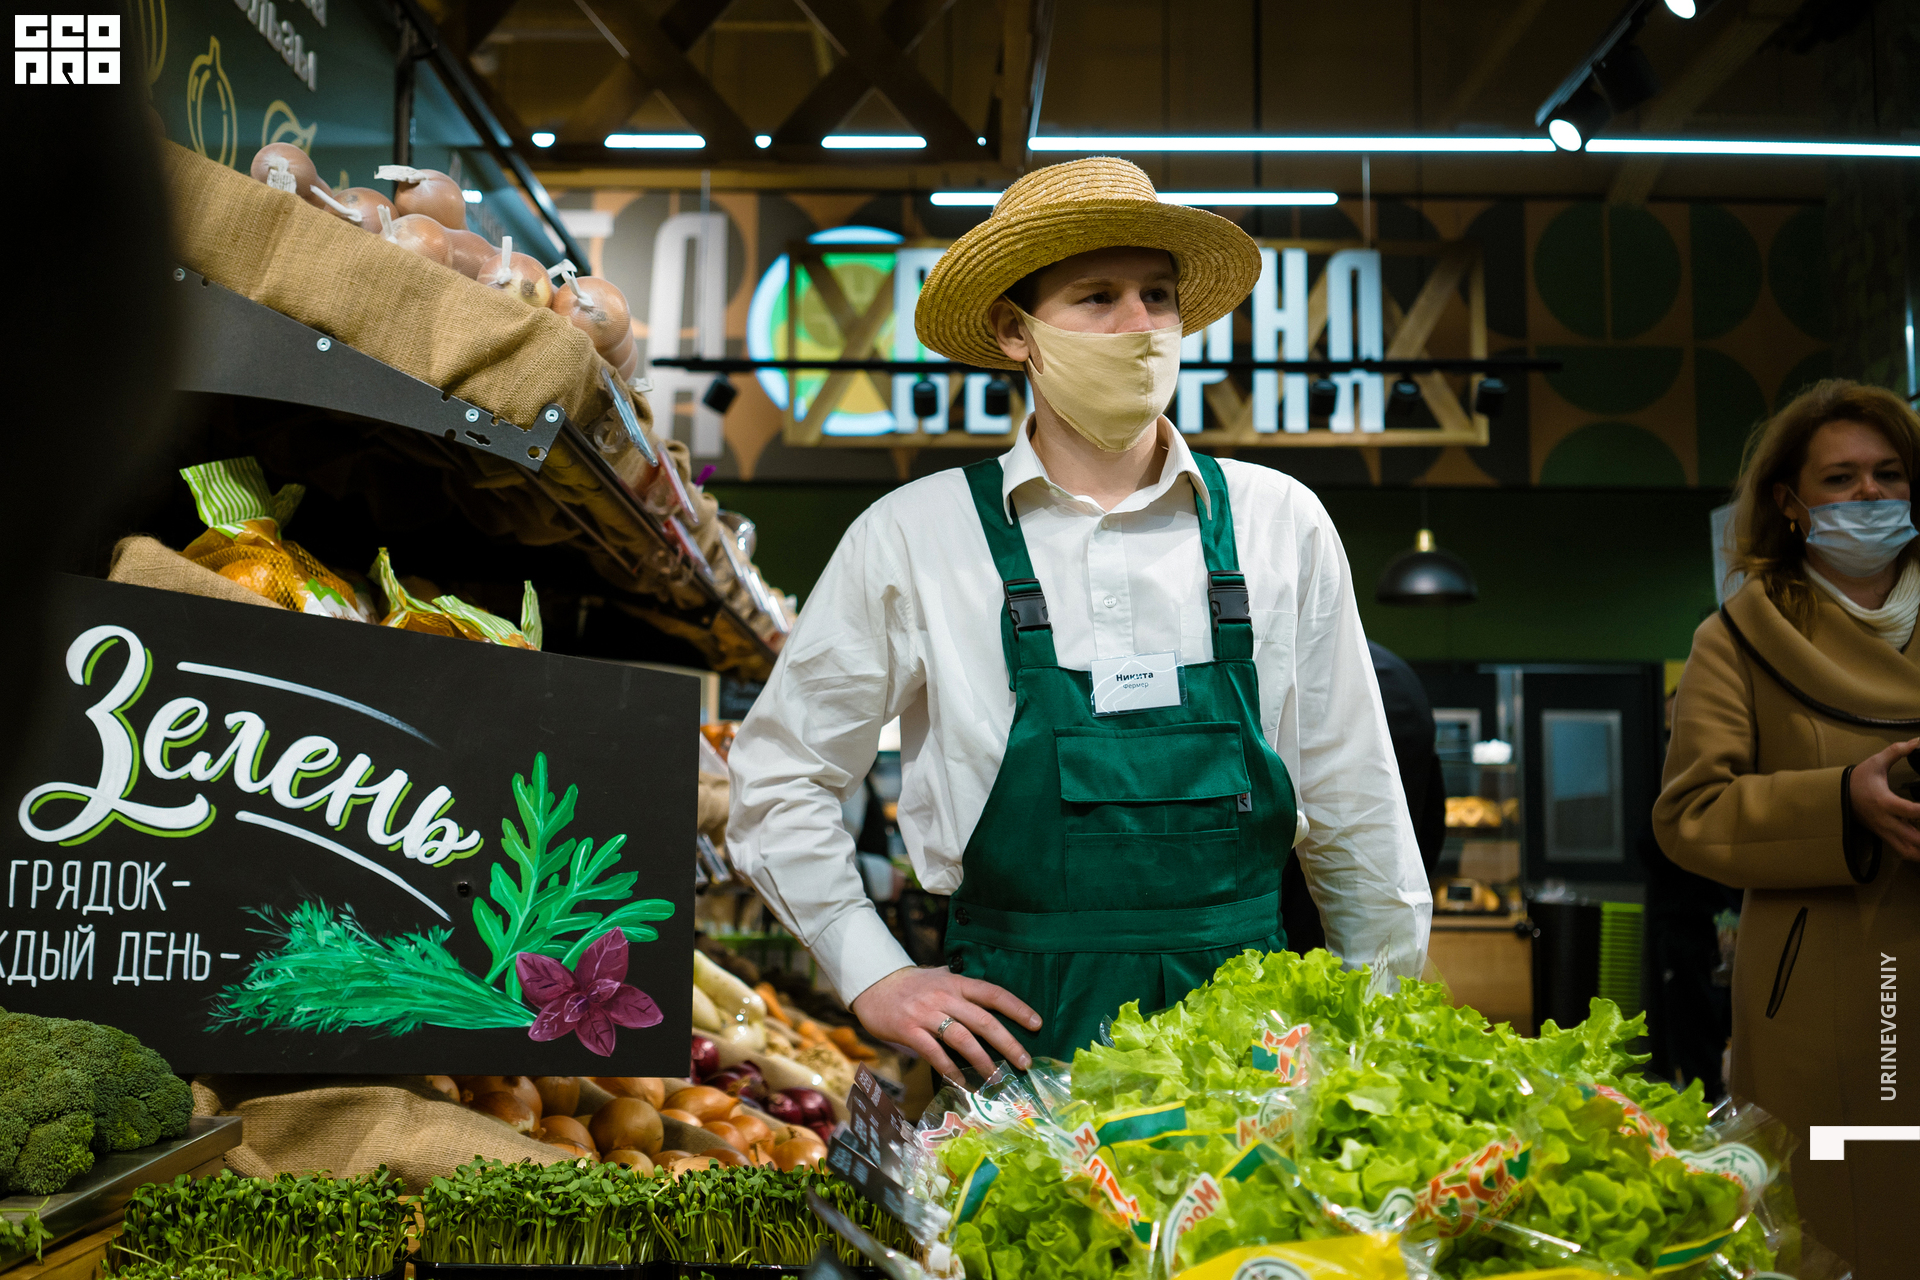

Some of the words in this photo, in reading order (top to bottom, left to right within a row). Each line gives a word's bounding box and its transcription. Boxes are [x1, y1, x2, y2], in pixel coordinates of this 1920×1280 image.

[1116, 671, 1154, 682] Никита
[1123, 682, 1150, 690] Фермер
[18, 625, 484, 867] Зелень
[0, 924, 96, 988] ДЫЙ
